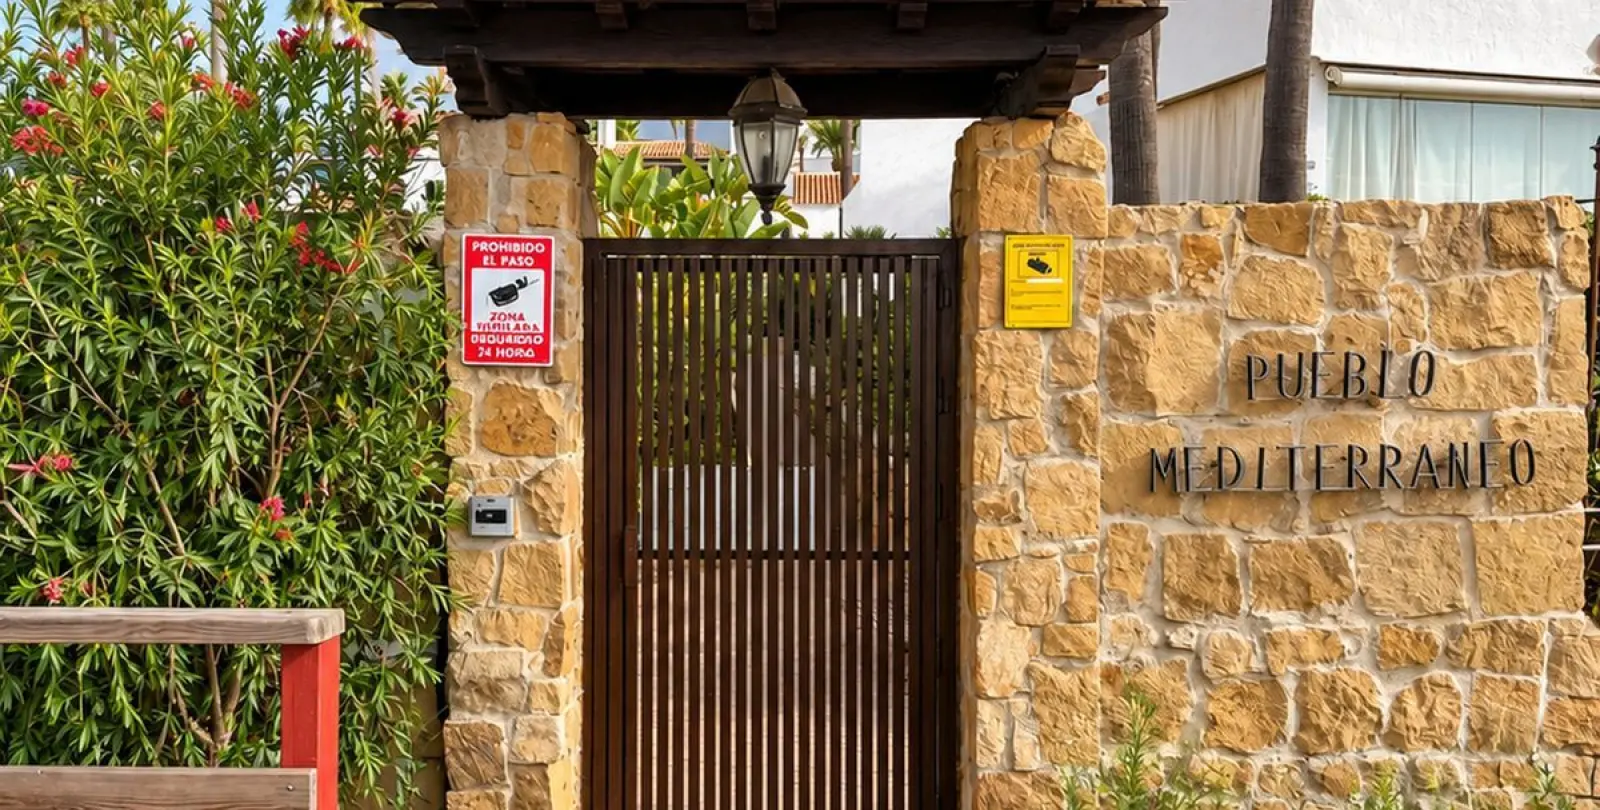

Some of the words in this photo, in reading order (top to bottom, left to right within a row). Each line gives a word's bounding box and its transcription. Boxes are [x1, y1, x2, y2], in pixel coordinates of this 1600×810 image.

[472, 241, 545, 253] PROHIBIDO
[483, 255, 496, 266] EL
[501, 256, 534, 266] PASO
[489, 312, 525, 321] ZONA
[1246, 349, 1436, 400] PUEBLO
[1149, 438, 1536, 493] MEDITERRANEO
